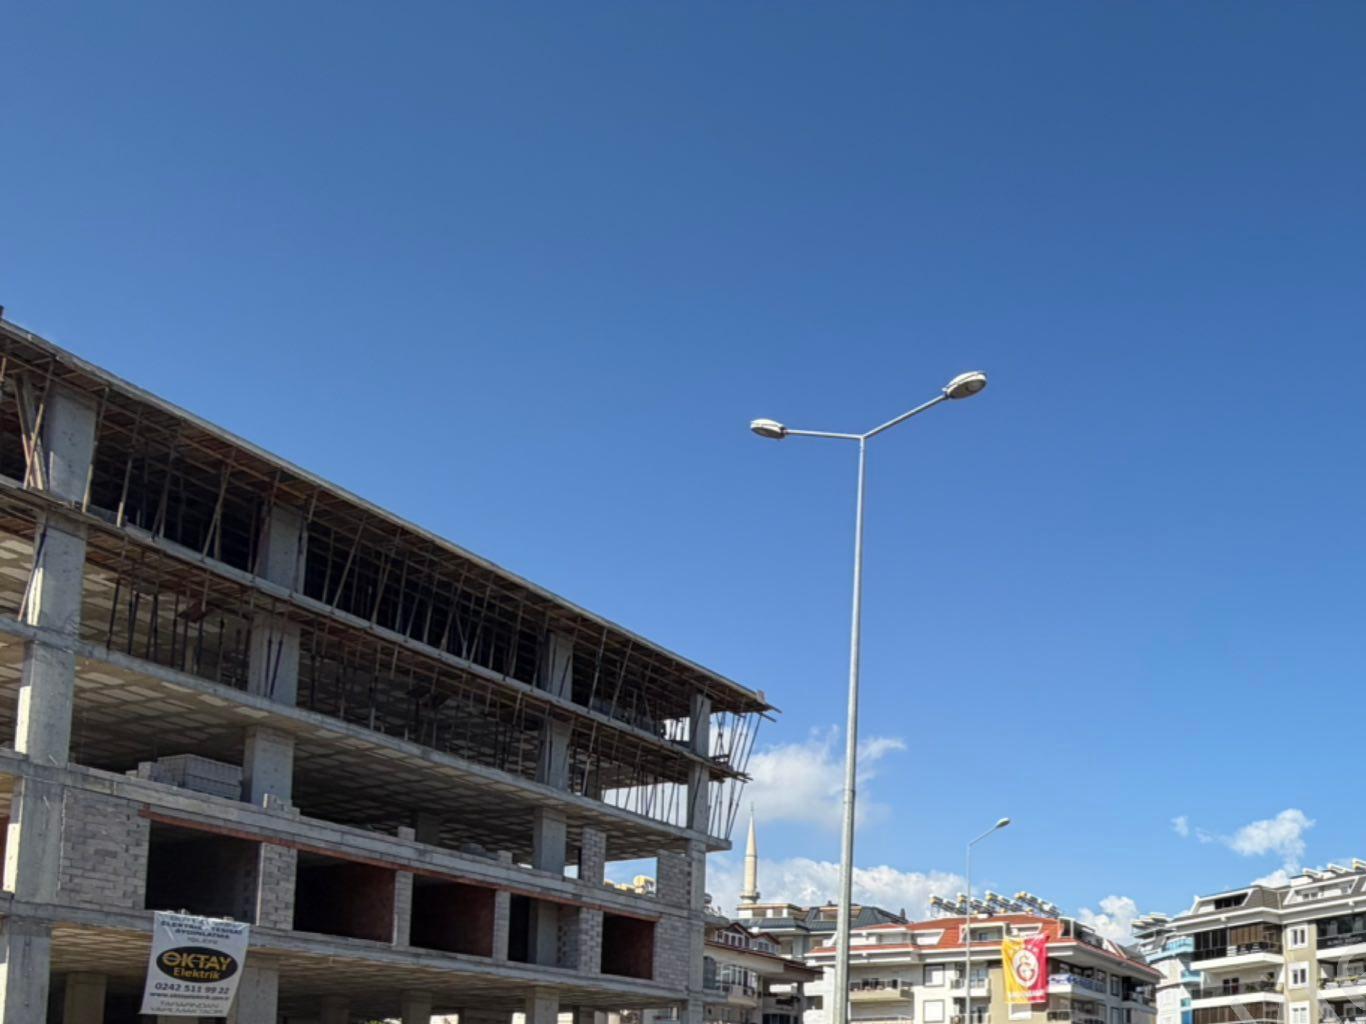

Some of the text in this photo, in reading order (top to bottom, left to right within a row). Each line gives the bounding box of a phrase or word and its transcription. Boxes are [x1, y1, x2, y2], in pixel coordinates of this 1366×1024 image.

[162, 951, 231, 971] OKTAY
[173, 968, 220, 979] Elektrik
[155, 982, 181, 992] 0242
[184, 985, 202, 993] 511
